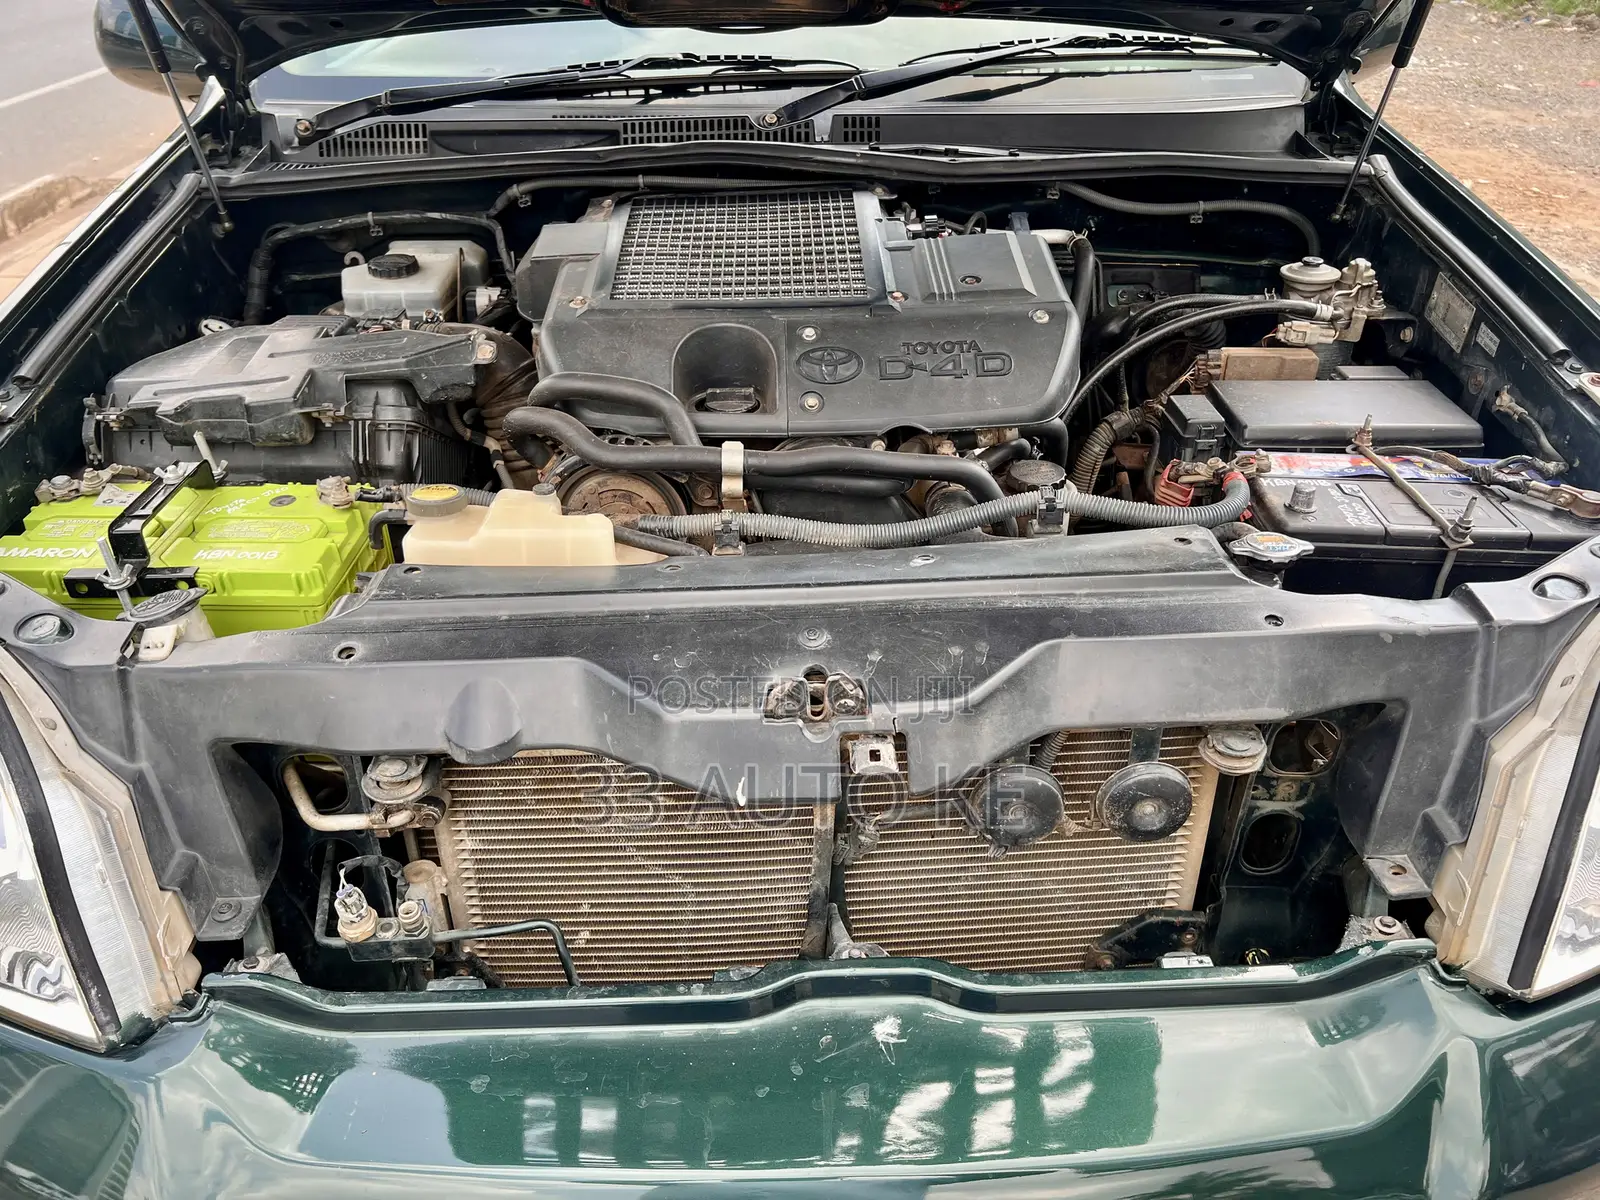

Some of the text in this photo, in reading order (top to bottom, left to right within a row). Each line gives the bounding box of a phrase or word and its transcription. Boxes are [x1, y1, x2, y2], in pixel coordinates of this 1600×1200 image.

[901, 340, 982, 355] TOYOTA
[879, 351, 1013, 380] D-4D
[193, 549, 236, 560] KBN
